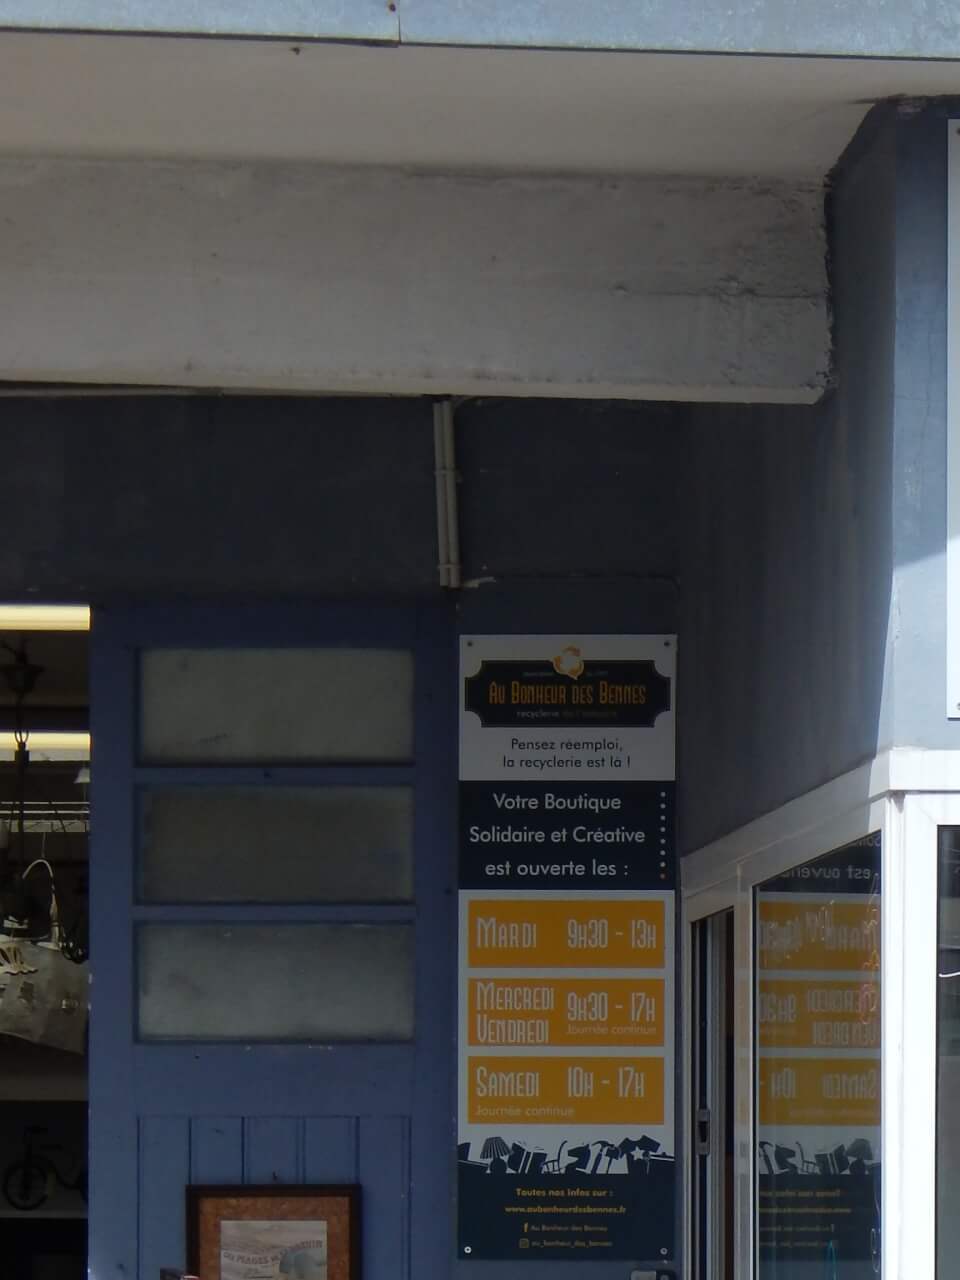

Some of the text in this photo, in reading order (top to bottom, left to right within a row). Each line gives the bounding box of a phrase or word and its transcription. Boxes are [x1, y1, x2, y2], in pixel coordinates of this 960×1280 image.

[488, 680, 648, 704] AU BONHEUR DES BENNES
[511, 738, 623, 753] Pensez réemploi,
[503, 755, 622, 770] la recyclerie est là
[493, 793, 622, 814] Votre Boutique
[469, 826, 646, 843] Solidaire et Créative
[485, 858, 617, 877] est ouverte les
[476, 917, 537, 948] MARDI
[476, 981, 554, 1011] MERCREDI
[476, 1066, 539, 1098] SAMEDI
[516, 1187, 546, 1197] Toutes
[548, 1188, 565, 1197] nos
[592, 1188, 608, 1197] sur
